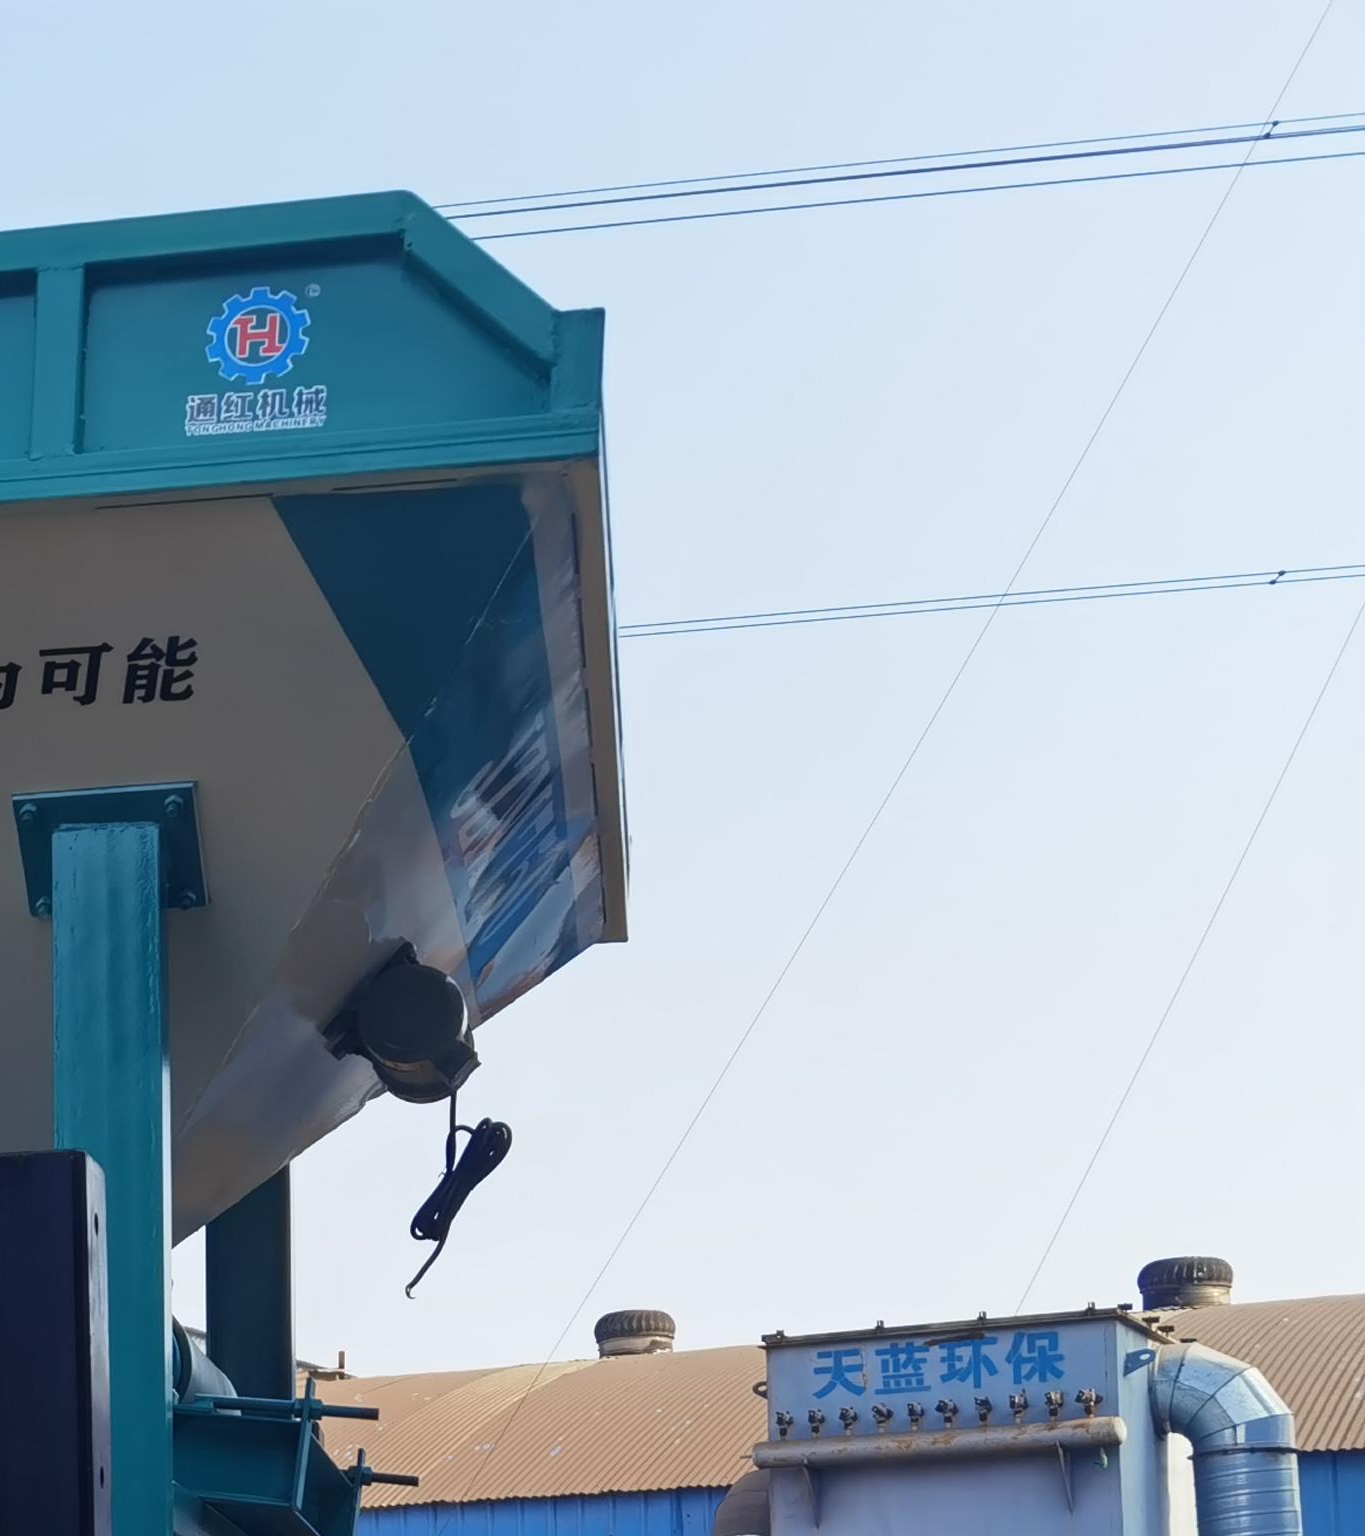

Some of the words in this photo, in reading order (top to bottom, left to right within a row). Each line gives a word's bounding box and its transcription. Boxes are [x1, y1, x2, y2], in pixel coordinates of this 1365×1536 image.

[184, 385, 328, 425] 通红机械
[811, 1329, 1068, 1401] 天蓝环保
